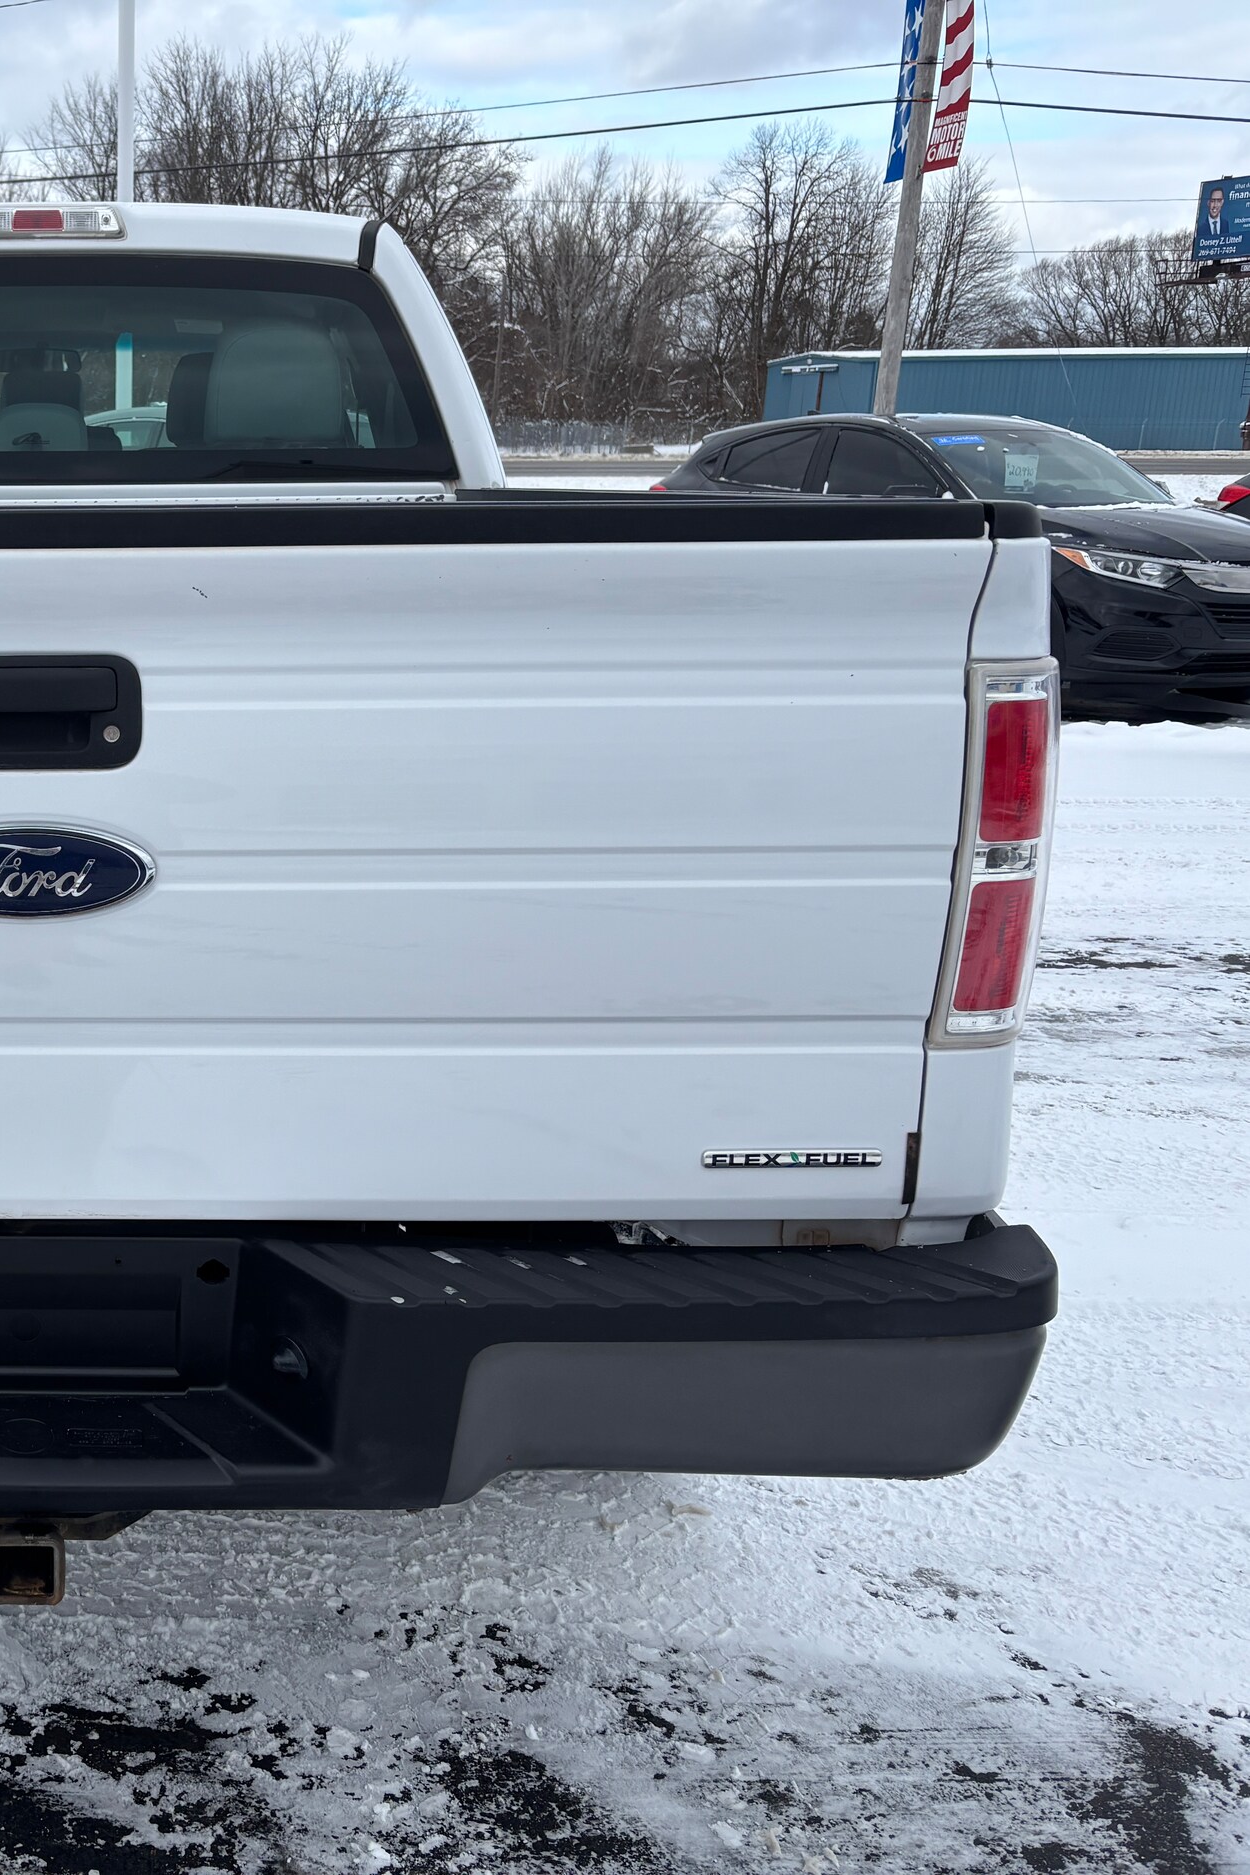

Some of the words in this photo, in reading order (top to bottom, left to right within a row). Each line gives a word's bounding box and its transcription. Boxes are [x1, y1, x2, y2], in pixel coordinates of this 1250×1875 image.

[935, 110, 968, 127] MAGNIFICENT
[930, 121, 966, 145] MOTOR
[927, 145, 937, 163] 6
[936, 139, 963, 161] MILE
[1199, 239, 1219, 247] Dorsey
[1226, 235, 1243, 244] Littell
[711, 1153, 782, 1167] FLEX
[805, 1152, 876, 1166] FUEL
